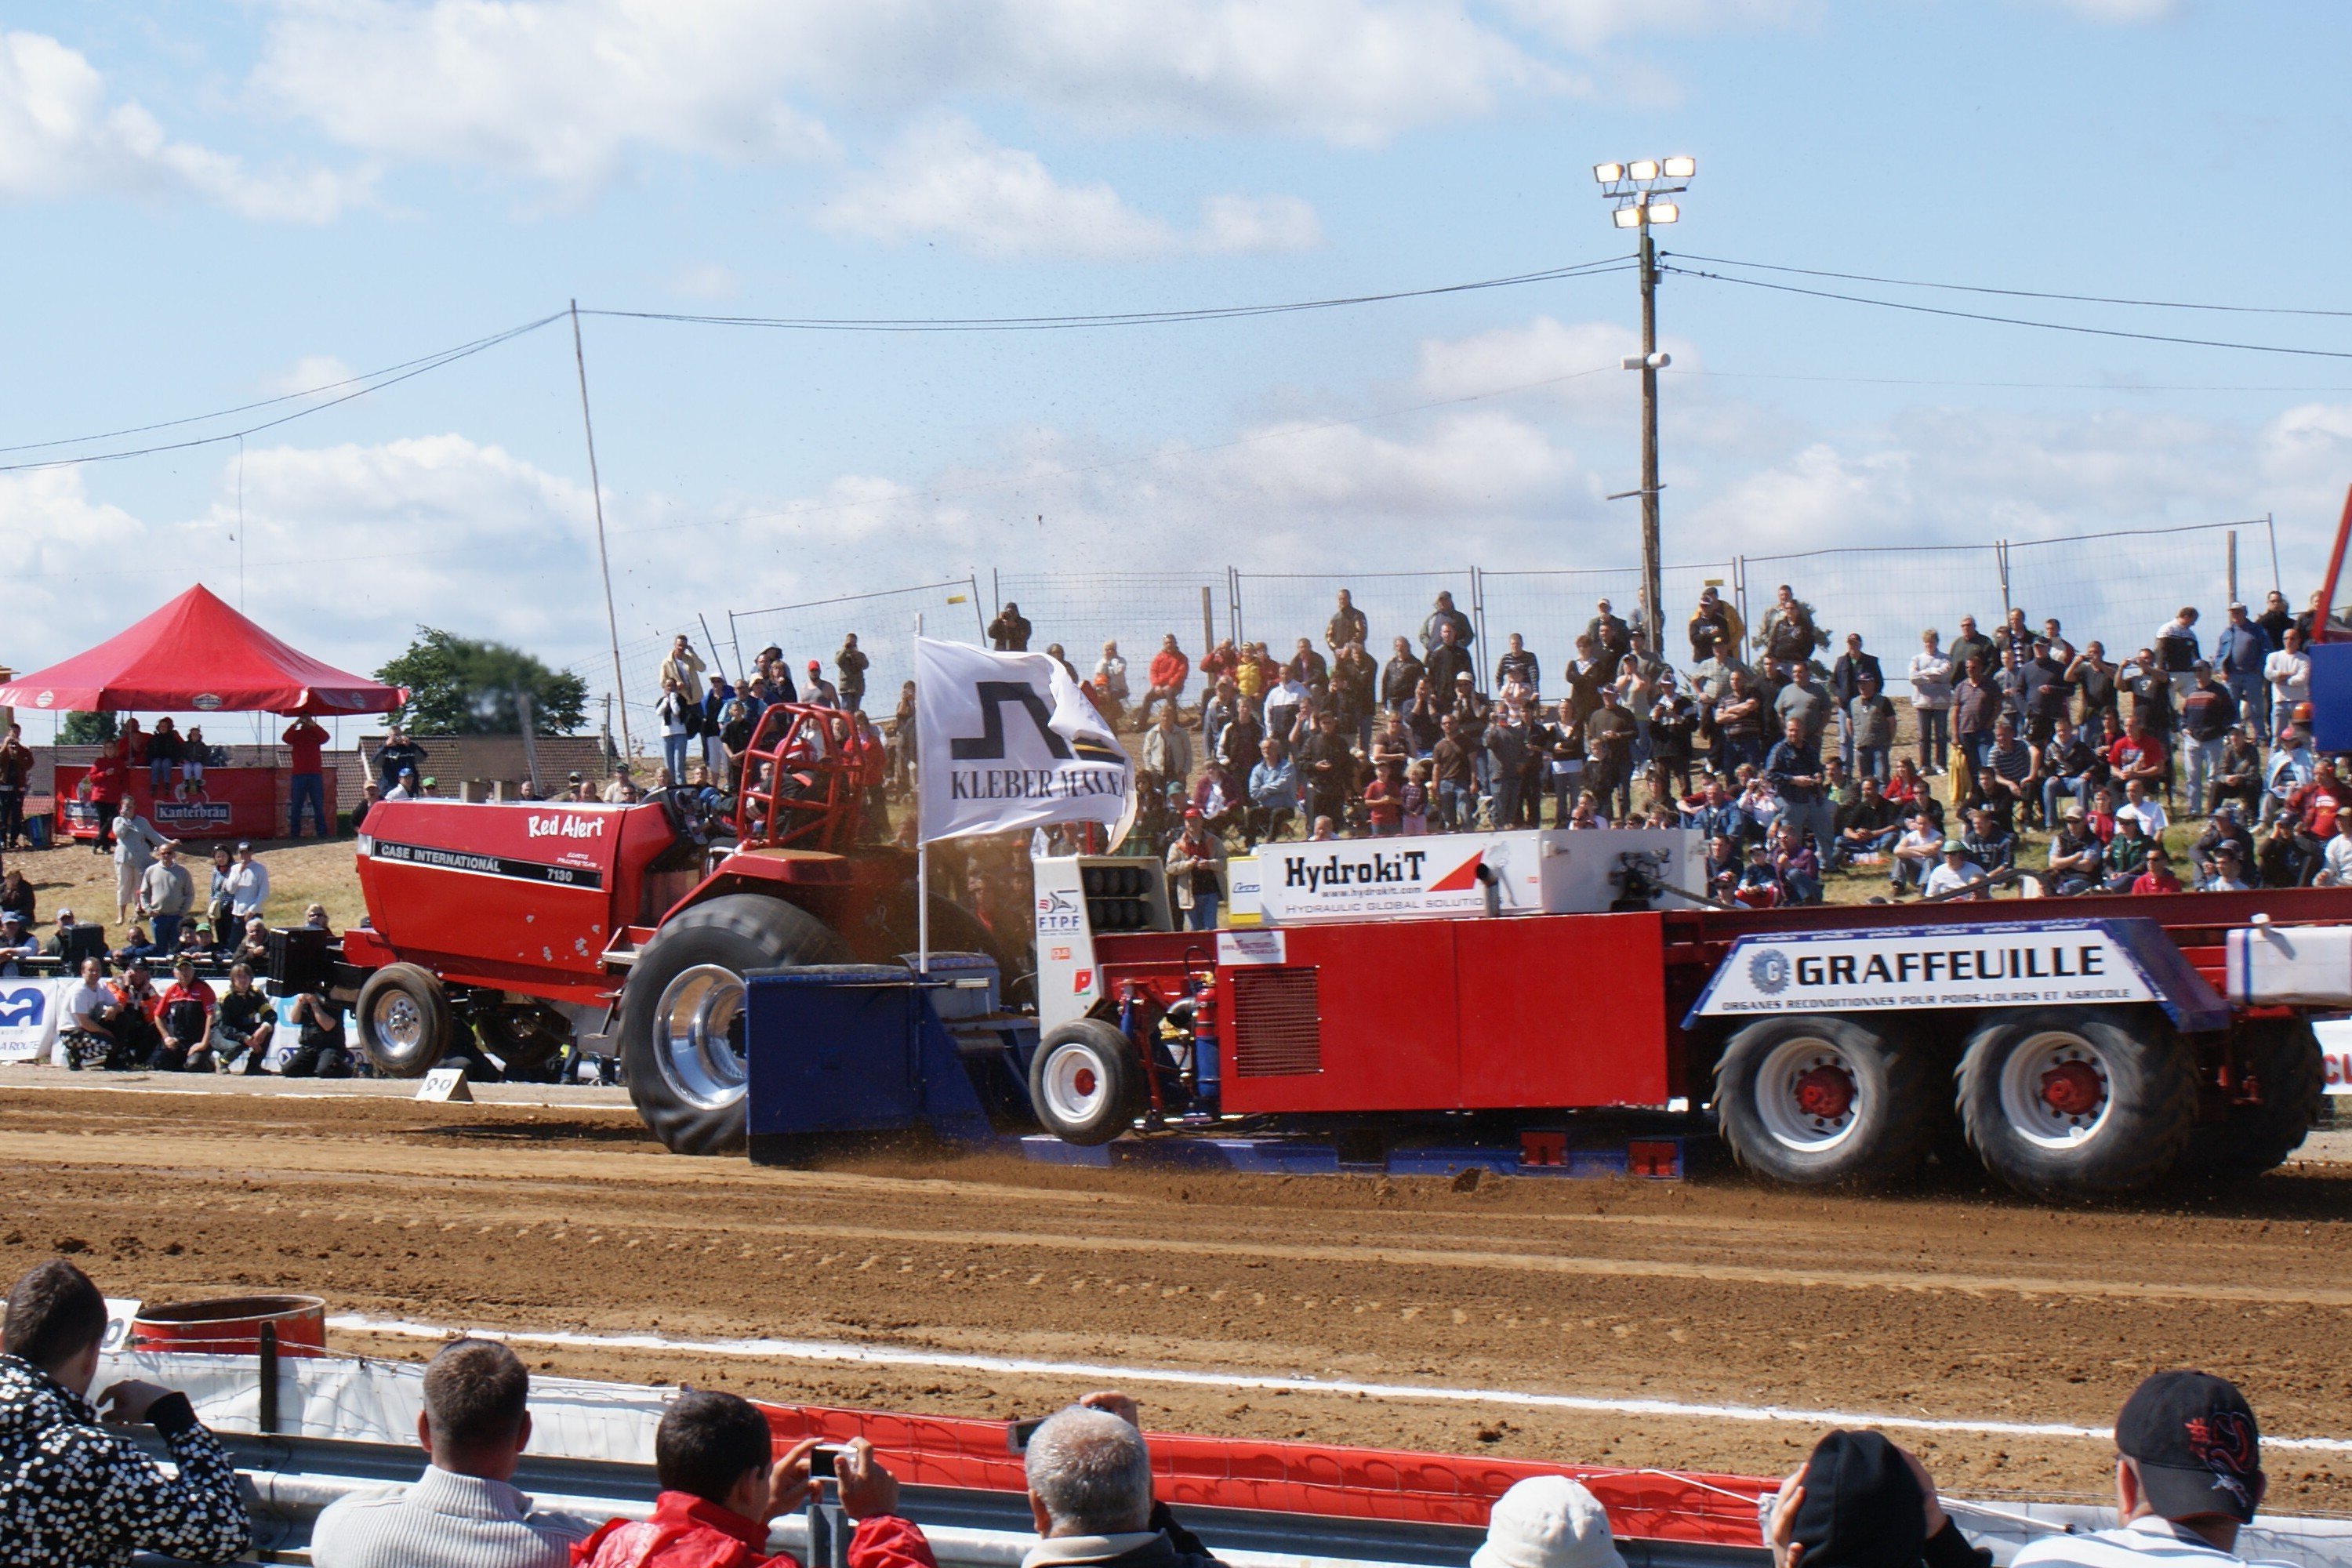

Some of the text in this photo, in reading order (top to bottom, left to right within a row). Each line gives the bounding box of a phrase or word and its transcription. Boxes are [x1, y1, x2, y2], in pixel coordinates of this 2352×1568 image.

[951, 769, 1052, 799] KLEBER
[158, 807, 227, 818] Kanterbräu
[528, 815, 605, 838] Red Alert
[381, 843, 501, 873] CASE INTERNATIONAL
[547, 868, 573, 883] 7130
[1284, 850, 1426, 893] HydrokiT
[1321, 886, 1421, 898] www.hydrokit.com
[1285, 902, 1362, 914] HYDRAULIC
[1367, 900, 1420, 911] GLOBAL
[1038, 915, 1080, 928] FTPF
[1796, 946, 2104, 986] GRAFFEUILLE
[1722, 988, 2132, 1011] ORGANES RECONDITIONNES POUR POIDS-LOURDS ET AGRICOLE
